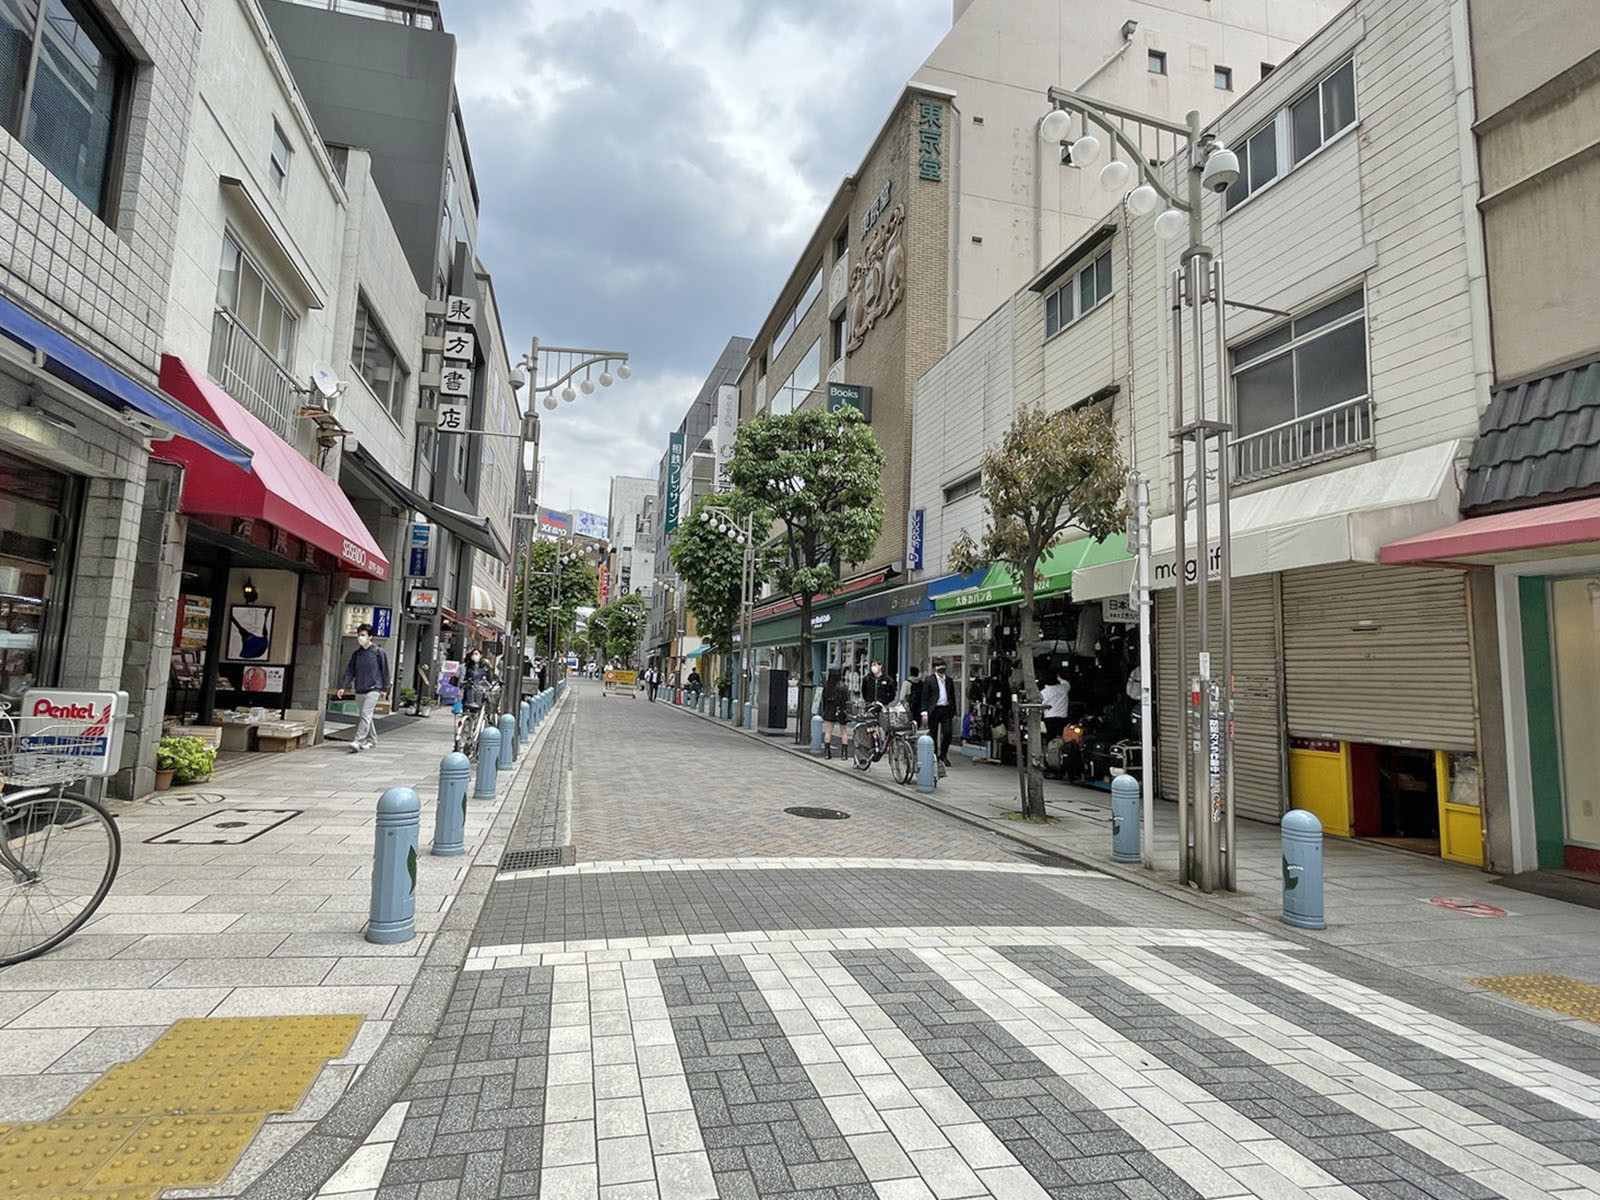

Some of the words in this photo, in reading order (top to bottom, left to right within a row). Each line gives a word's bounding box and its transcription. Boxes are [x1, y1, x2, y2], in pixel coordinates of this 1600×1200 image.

[919, 102, 942, 183] 東京堂
[438, 300, 471, 429] 東方書店
[831, 387, 859, 398] Books
[668, 444, 682, 523] 相鉄フレッサイン
[33, 698, 95, 719] Pentel
